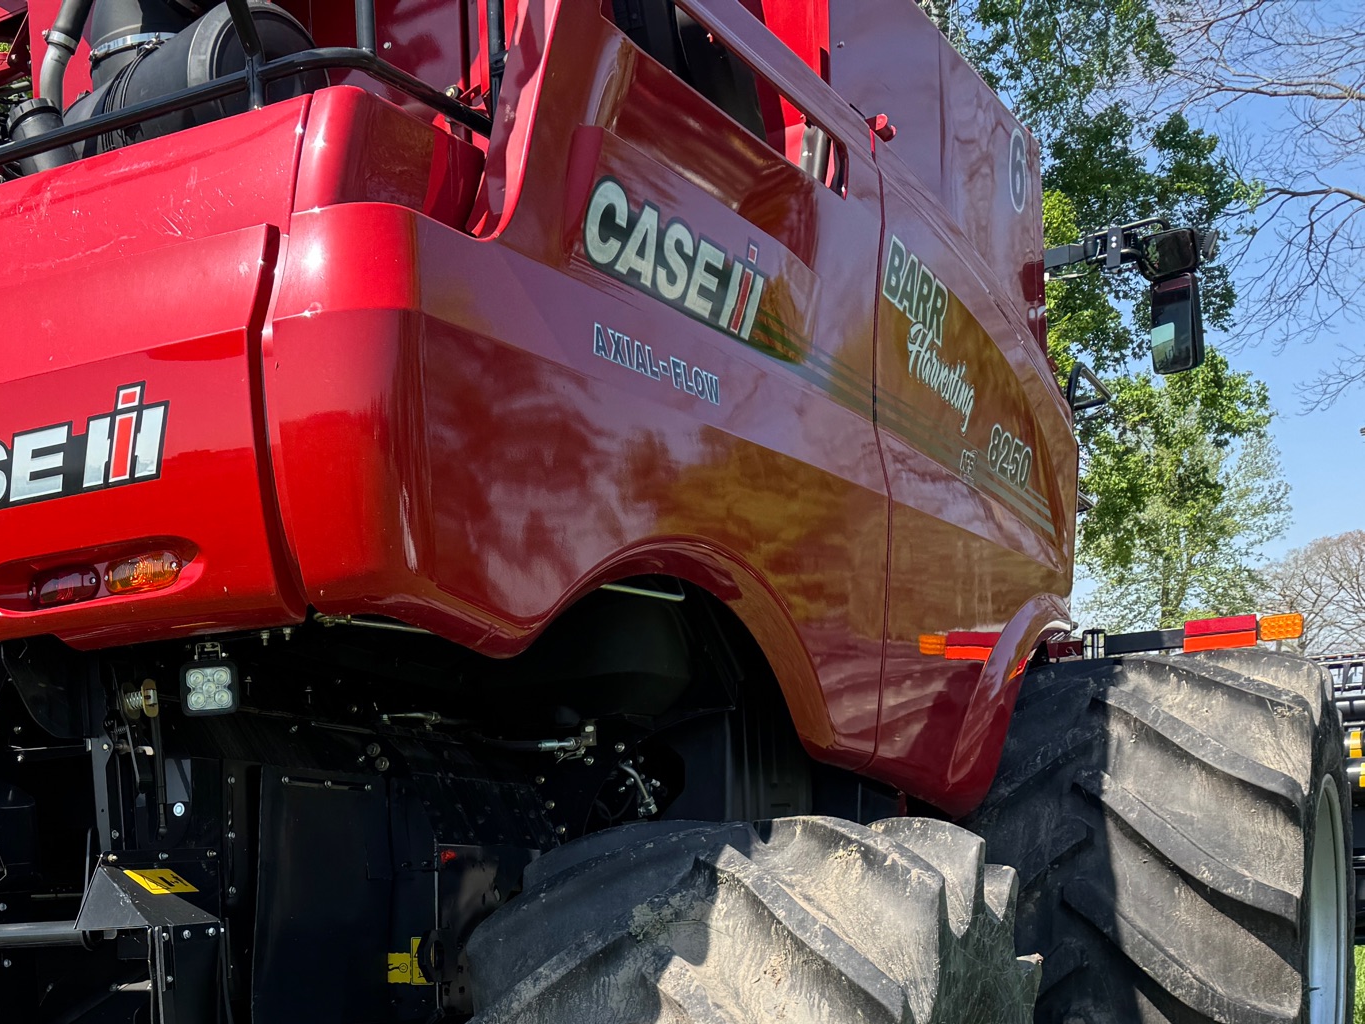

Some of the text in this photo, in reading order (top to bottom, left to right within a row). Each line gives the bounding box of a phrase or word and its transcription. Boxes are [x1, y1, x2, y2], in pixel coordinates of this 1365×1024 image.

[1009, 128, 1026, 214] 6
[585, 180, 726, 319] CASE
[882, 234, 949, 348] BARR
[593, 321, 720, 406] AXIAL-FLOW
[906, 320, 976, 436] Harvesting
[988, 423, 1032, 490] 8250
